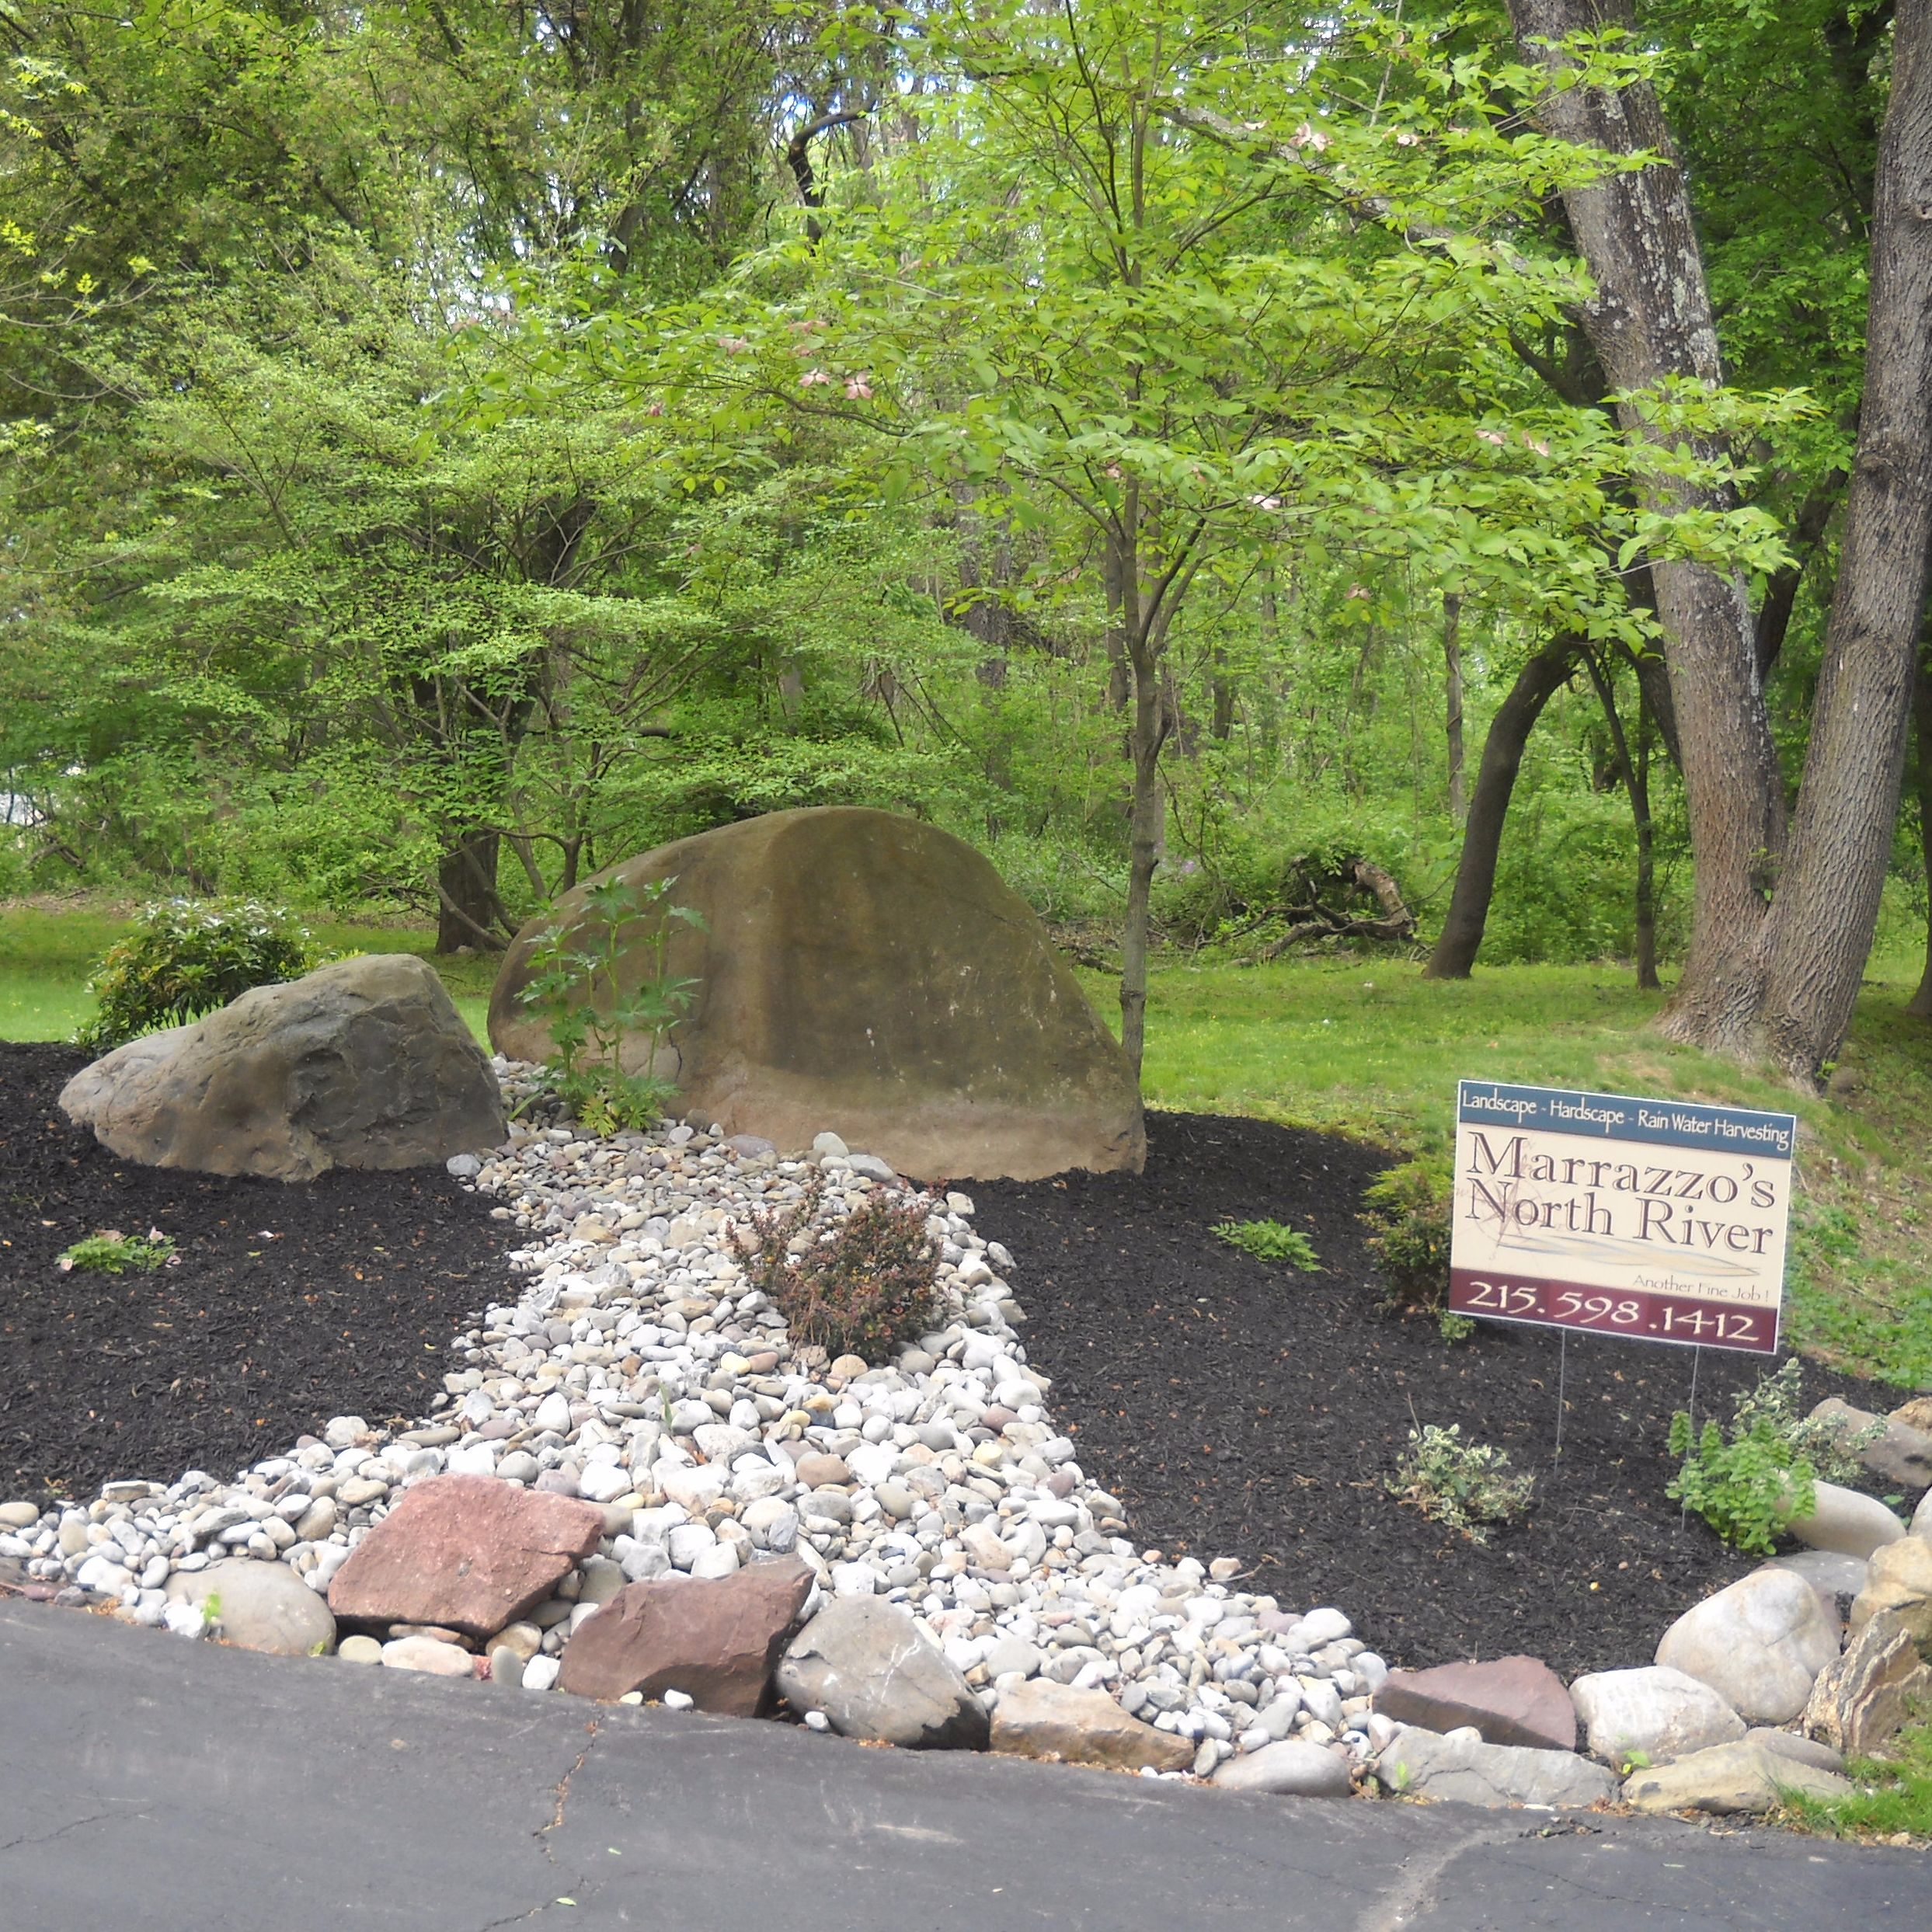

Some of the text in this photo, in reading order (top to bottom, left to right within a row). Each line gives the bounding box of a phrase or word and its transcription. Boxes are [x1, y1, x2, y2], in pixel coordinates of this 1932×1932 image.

[1462, 1088, 1537, 1124] Landscape
[1550, 1097, 1624, 1133] Hardscape
[1638, 1109, 1668, 1130] Rain
[1672, 1112, 1711, 1134] Water
[1714, 1119, 1789, 1151] Harvesting
[1466, 1131, 1775, 1209] Marrazzo’s
[1464, 1177, 1774, 1255] North River
[1633, 1274, 1694, 1293] Another
[1698, 1283, 1728, 1297] Fine
